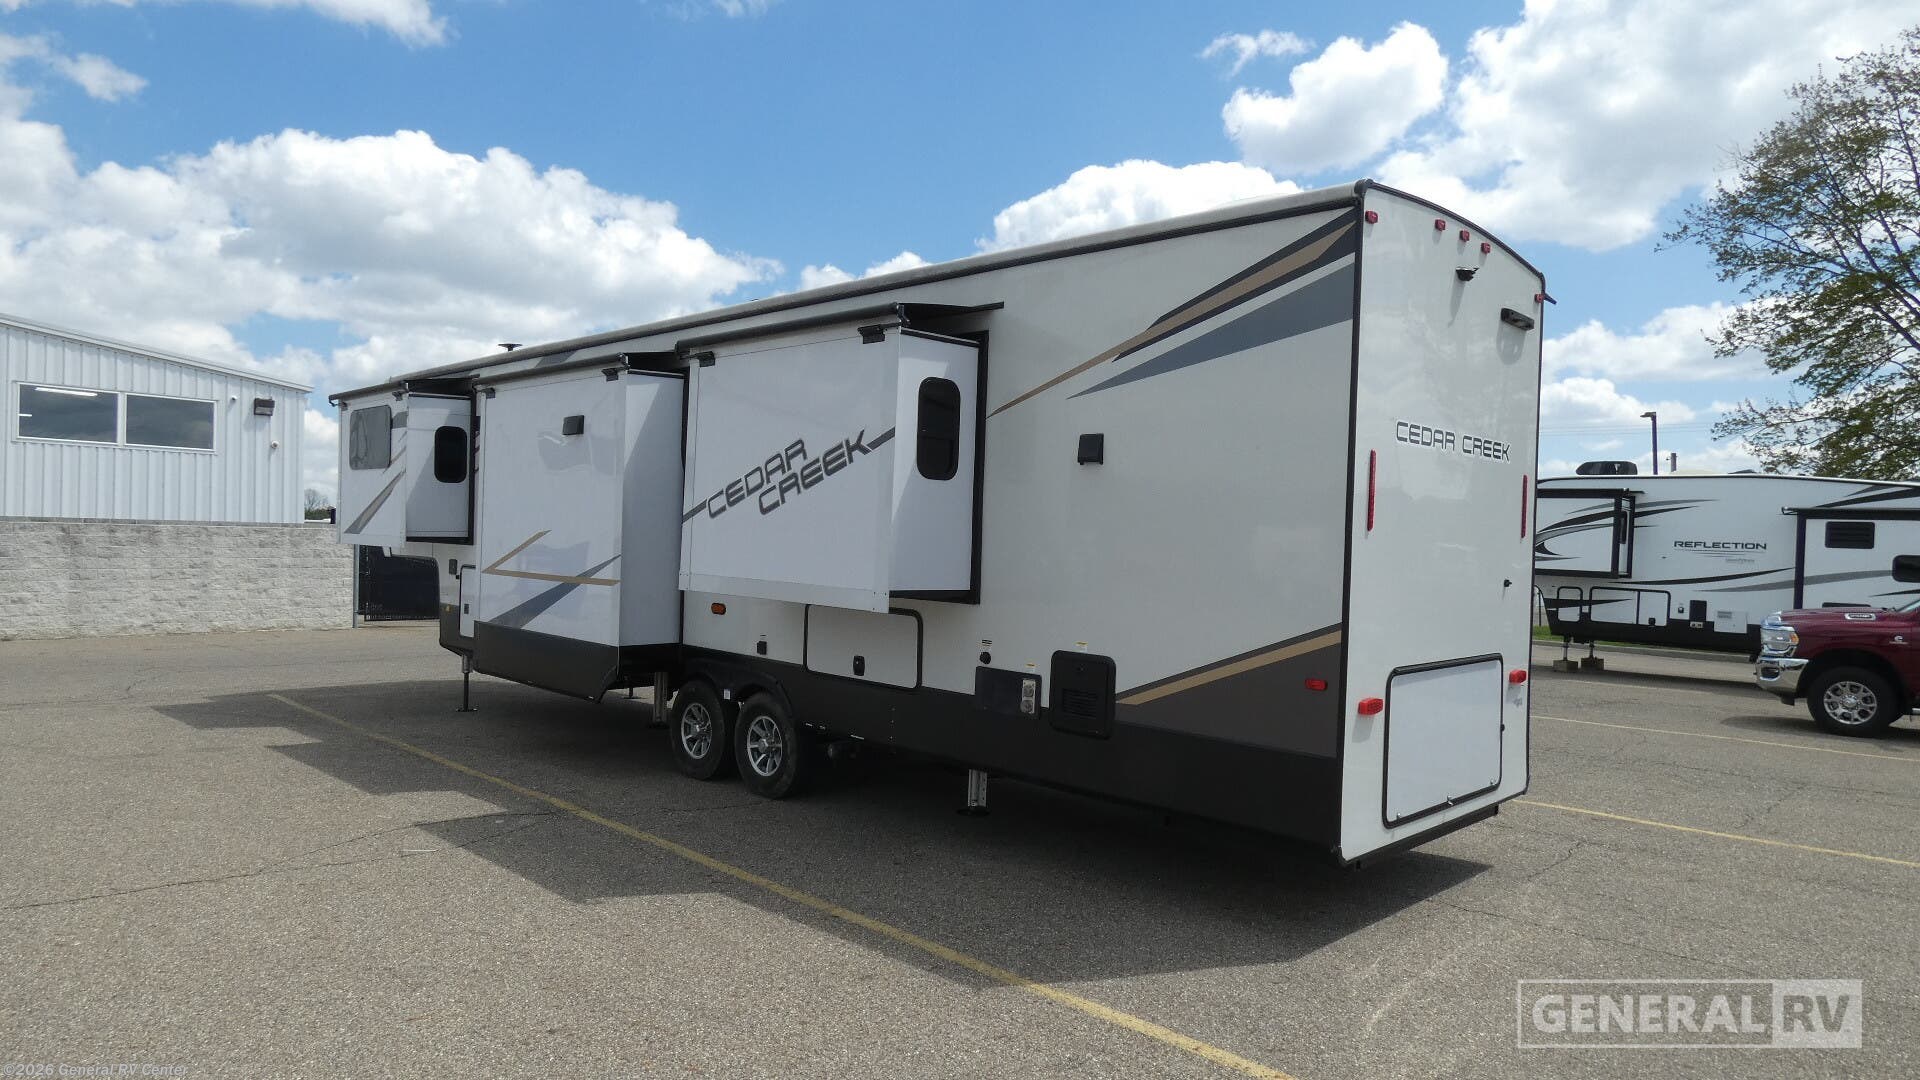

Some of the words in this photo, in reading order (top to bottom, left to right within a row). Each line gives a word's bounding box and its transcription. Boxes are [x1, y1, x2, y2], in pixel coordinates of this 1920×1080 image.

[1396, 420, 1456, 451] CEDAR
[1462, 435, 1511, 462] CREEK
[707, 438, 808, 519] CEDAR
[758, 428, 872, 516] CREEK
[1673, 540, 1767, 550] REFLECTION
